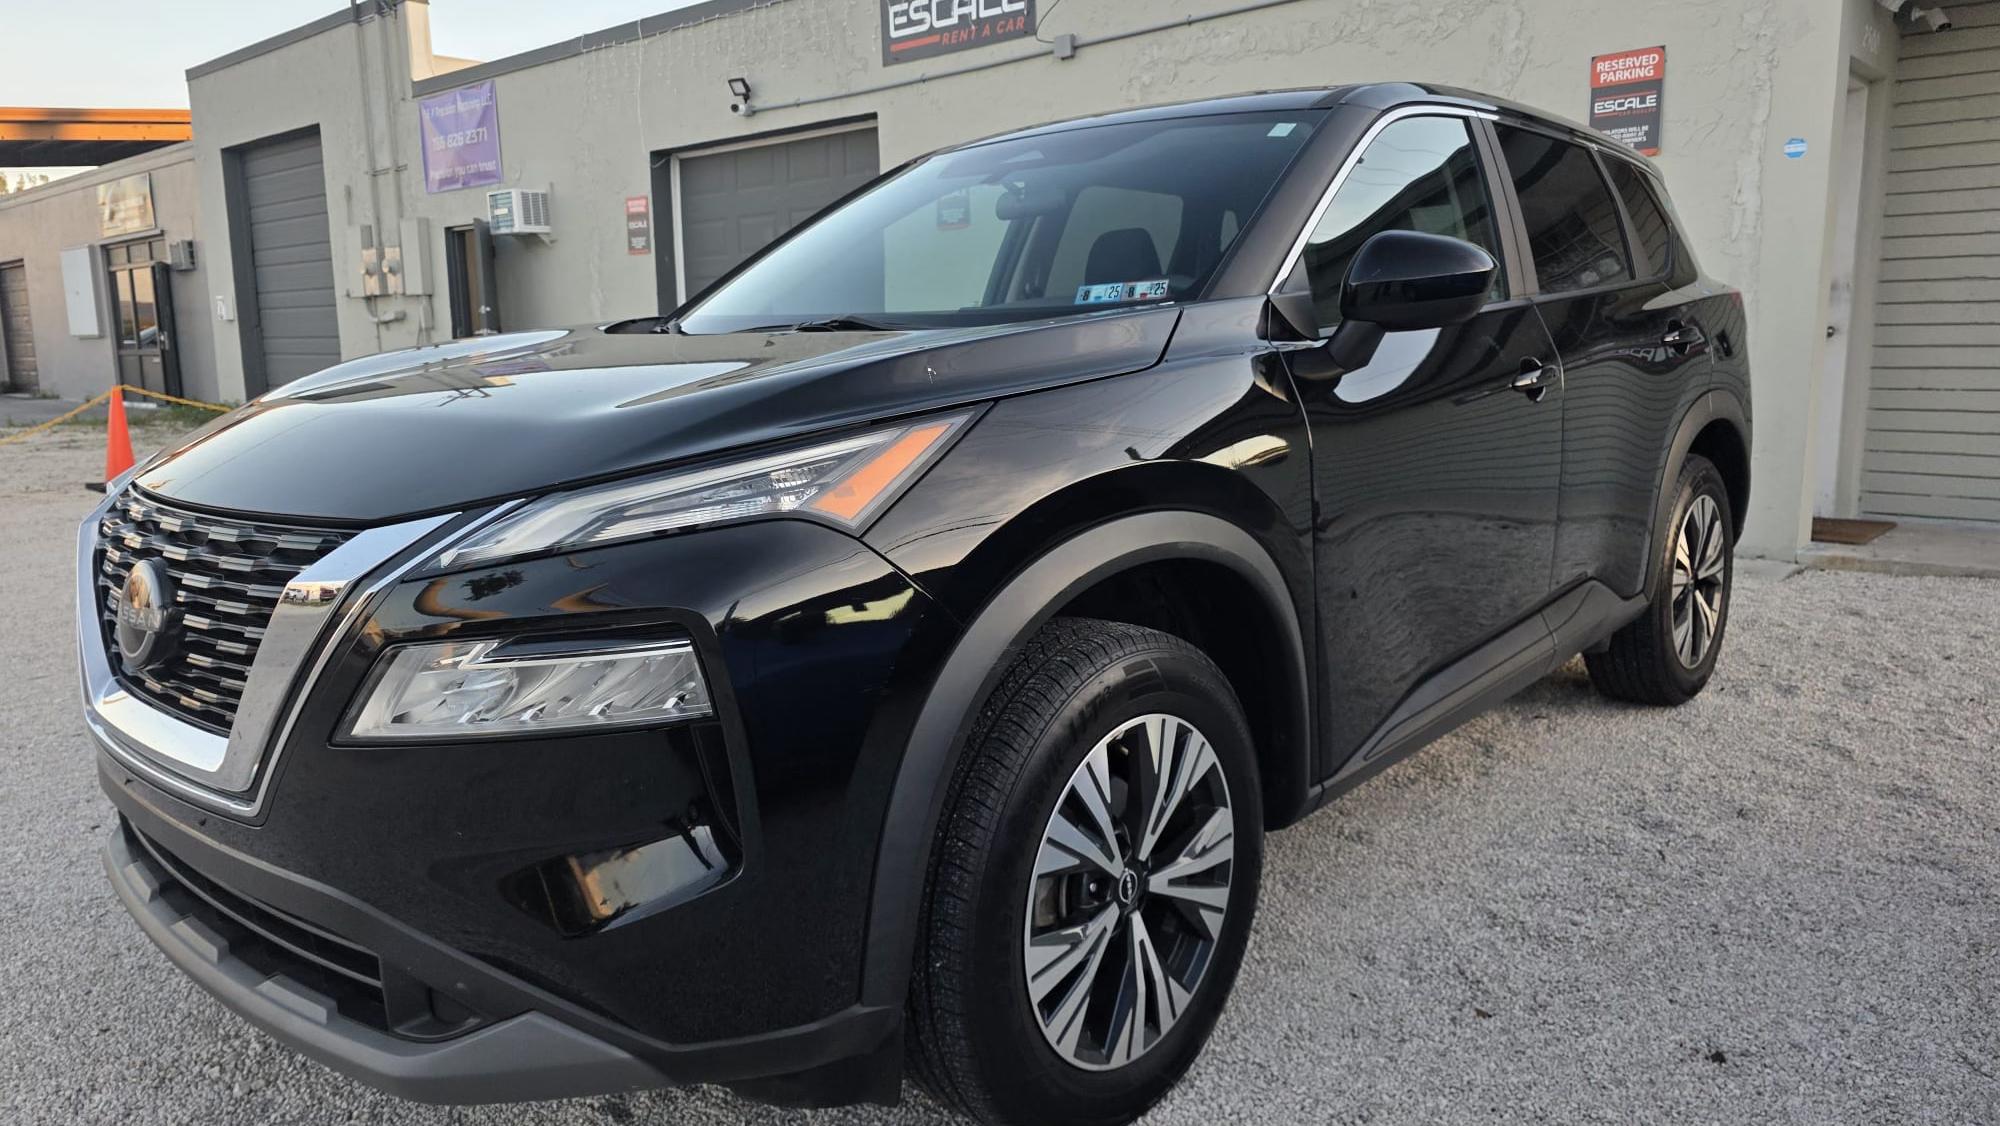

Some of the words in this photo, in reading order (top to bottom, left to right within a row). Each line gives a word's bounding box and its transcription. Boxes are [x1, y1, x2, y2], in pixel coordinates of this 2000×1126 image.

[942, 28, 977, 45] RENT
[982, 24, 991, 37] A
[996, 16, 1025, 34] CAR
[1596, 54, 1659, 73] RESERVED
[1600, 66, 1654, 83] PARKING
[1594, 95, 1657, 113] ESCALE
[1108, 285, 1121, 299] 25
[1154, 282, 1167, 296] 25
